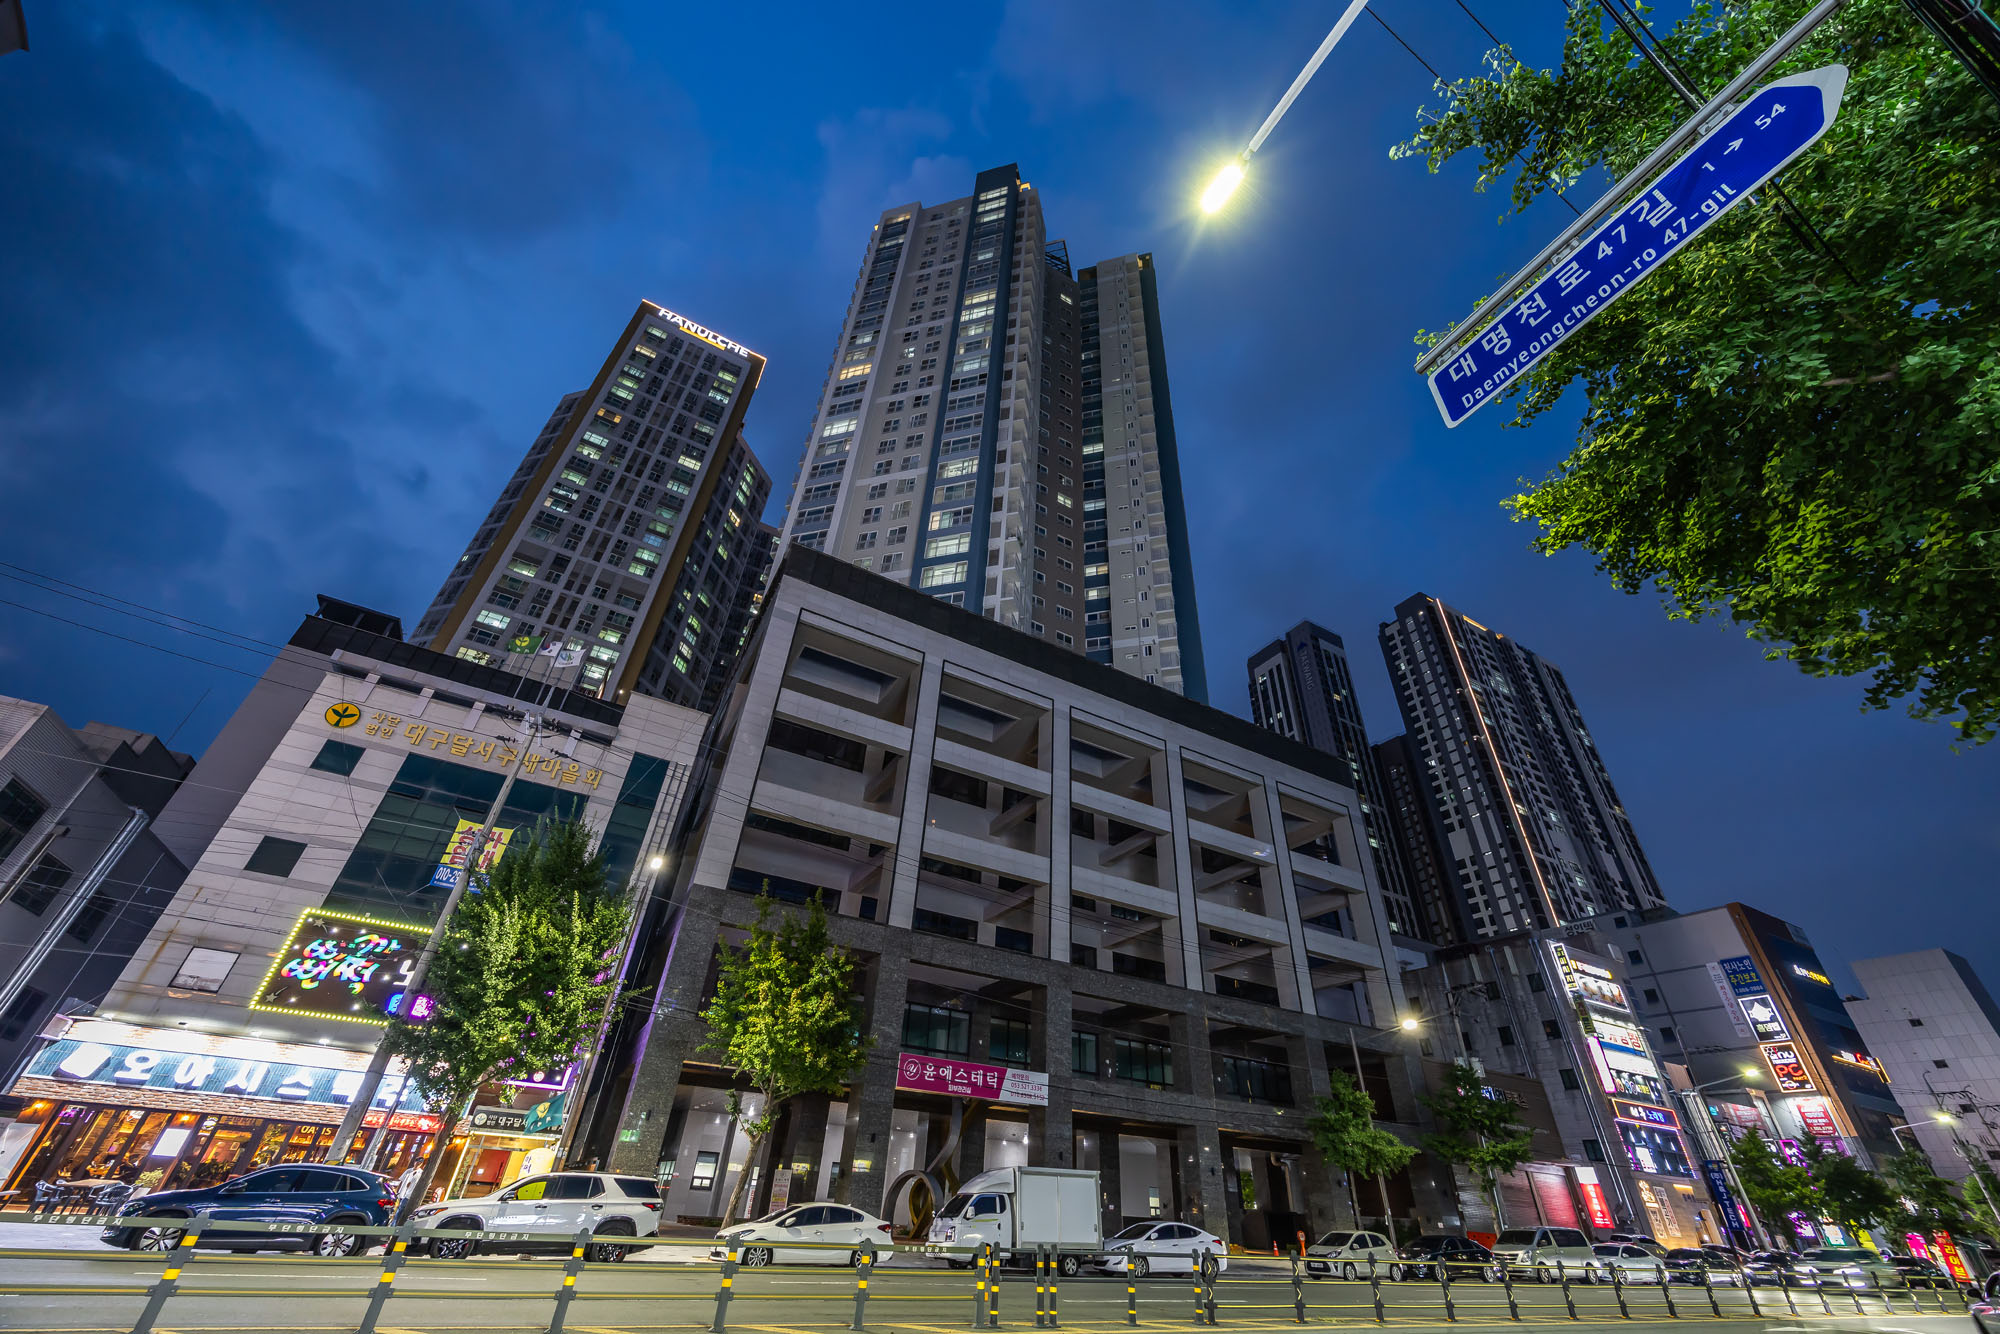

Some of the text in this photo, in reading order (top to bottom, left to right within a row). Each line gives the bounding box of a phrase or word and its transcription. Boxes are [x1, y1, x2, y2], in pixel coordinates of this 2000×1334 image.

[1702, 103, 1786, 172] 1 54
[1461, 183, 1736, 409] Daemyeongcheon-ro 47-gil
[371, 711, 404, 728] 사단
[365, 722, 396, 740] 법인
[403, 722, 604, 790] 대구달서구새마을회
[1729, 972, 1760, 986] 주간보호
[922, 1063, 998, 1089] 윤에스테틱
[1774, 1063, 1804, 1078] PC
